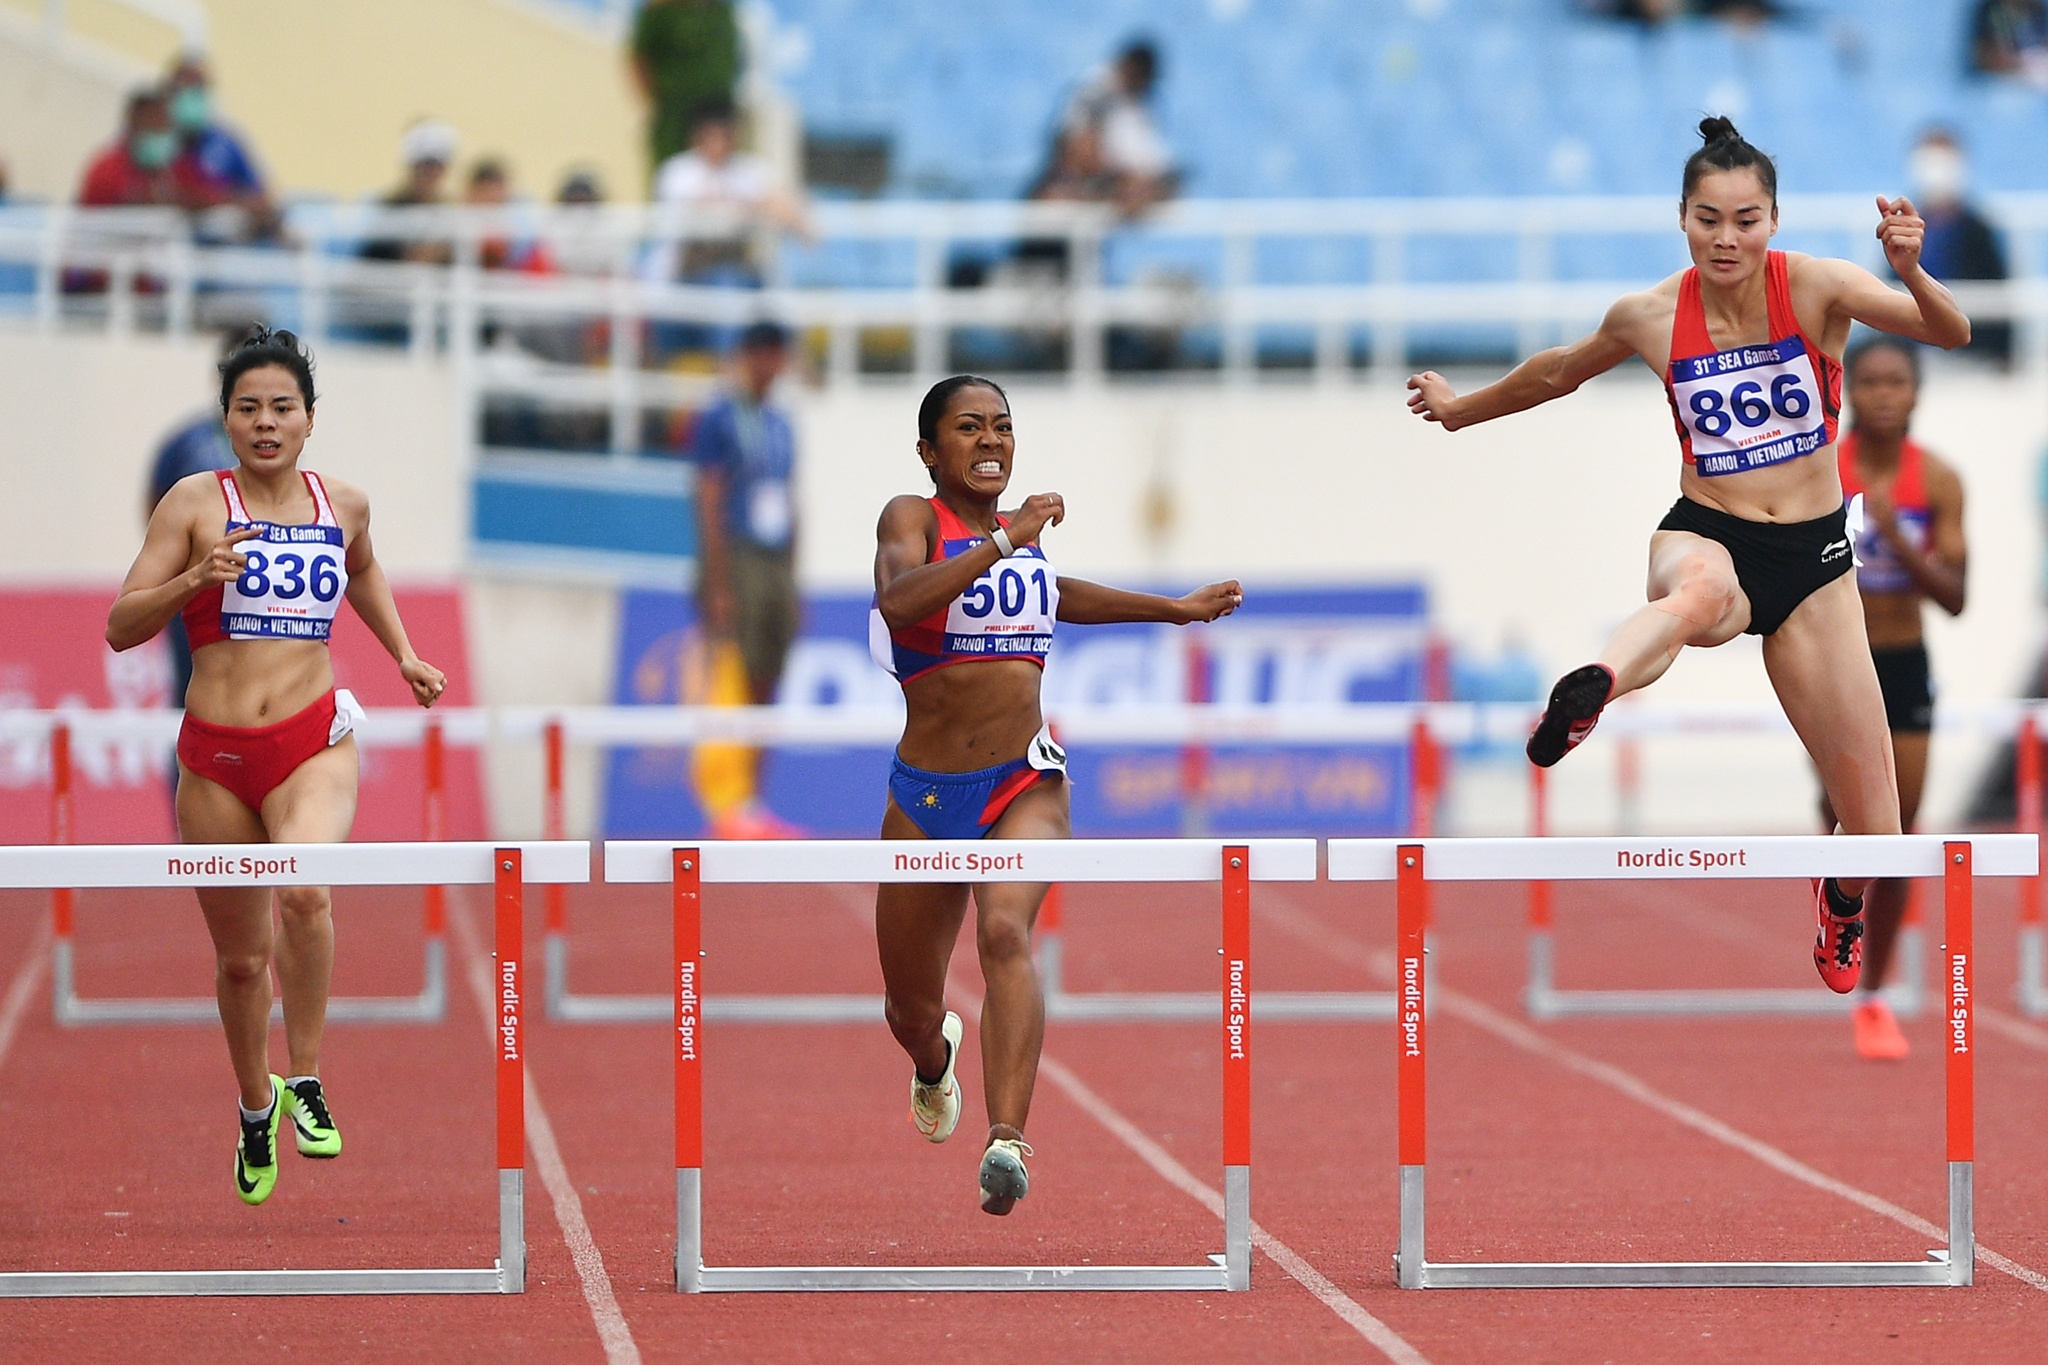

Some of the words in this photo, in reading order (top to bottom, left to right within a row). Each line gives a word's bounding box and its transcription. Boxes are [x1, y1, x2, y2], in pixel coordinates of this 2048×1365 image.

[1717, 351, 1743, 371] SEA
[1743, 348, 1781, 366] Games
[1689, 373, 1811, 437] 866
[1704, 454, 1739, 472] HANOI
[1745, 440, 1796, 466] VIETNAM
[1738, 429, 1782, 447] VIETNAM
[268, 525, 289, 542] SEA
[289, 527, 327, 542] Games
[236, 550, 340, 603] 836
[961, 568, 1049, 619] 501
[229, 616, 262, 632] HANOI
[270, 618, 313, 636] VIETNAM
[267, 606, 308, 615] VIETNAM
[984, 624, 1036, 632] PHILIPPINES
[952, 637, 986, 652] HANOI
[994, 637, 1033, 652] VIETNAM
[167, 856, 235, 875] nordic
[239, 856, 297, 879] Sport
[894, 851, 961, 870] nordic
[966, 852, 1024, 875] Sport
[1617, 848, 1684, 867] nordic
[1688, 849, 1747, 871] Sport
[502, 961, 519, 1013] nordic
[681, 961, 697, 1013] nordic
[1230, 959, 1246, 1011] nordic
[1404, 957, 1421, 1009] nordic
[1952, 954, 1969, 1006] nordic
[500, 1015, 519, 1060] Sport
[678, 1015, 697, 1060] Sport
[1227, 1014, 1245, 1059] Sport
[1402, 1011, 1420, 1056] Sport
[1950, 1008, 1969, 1053] Sport
